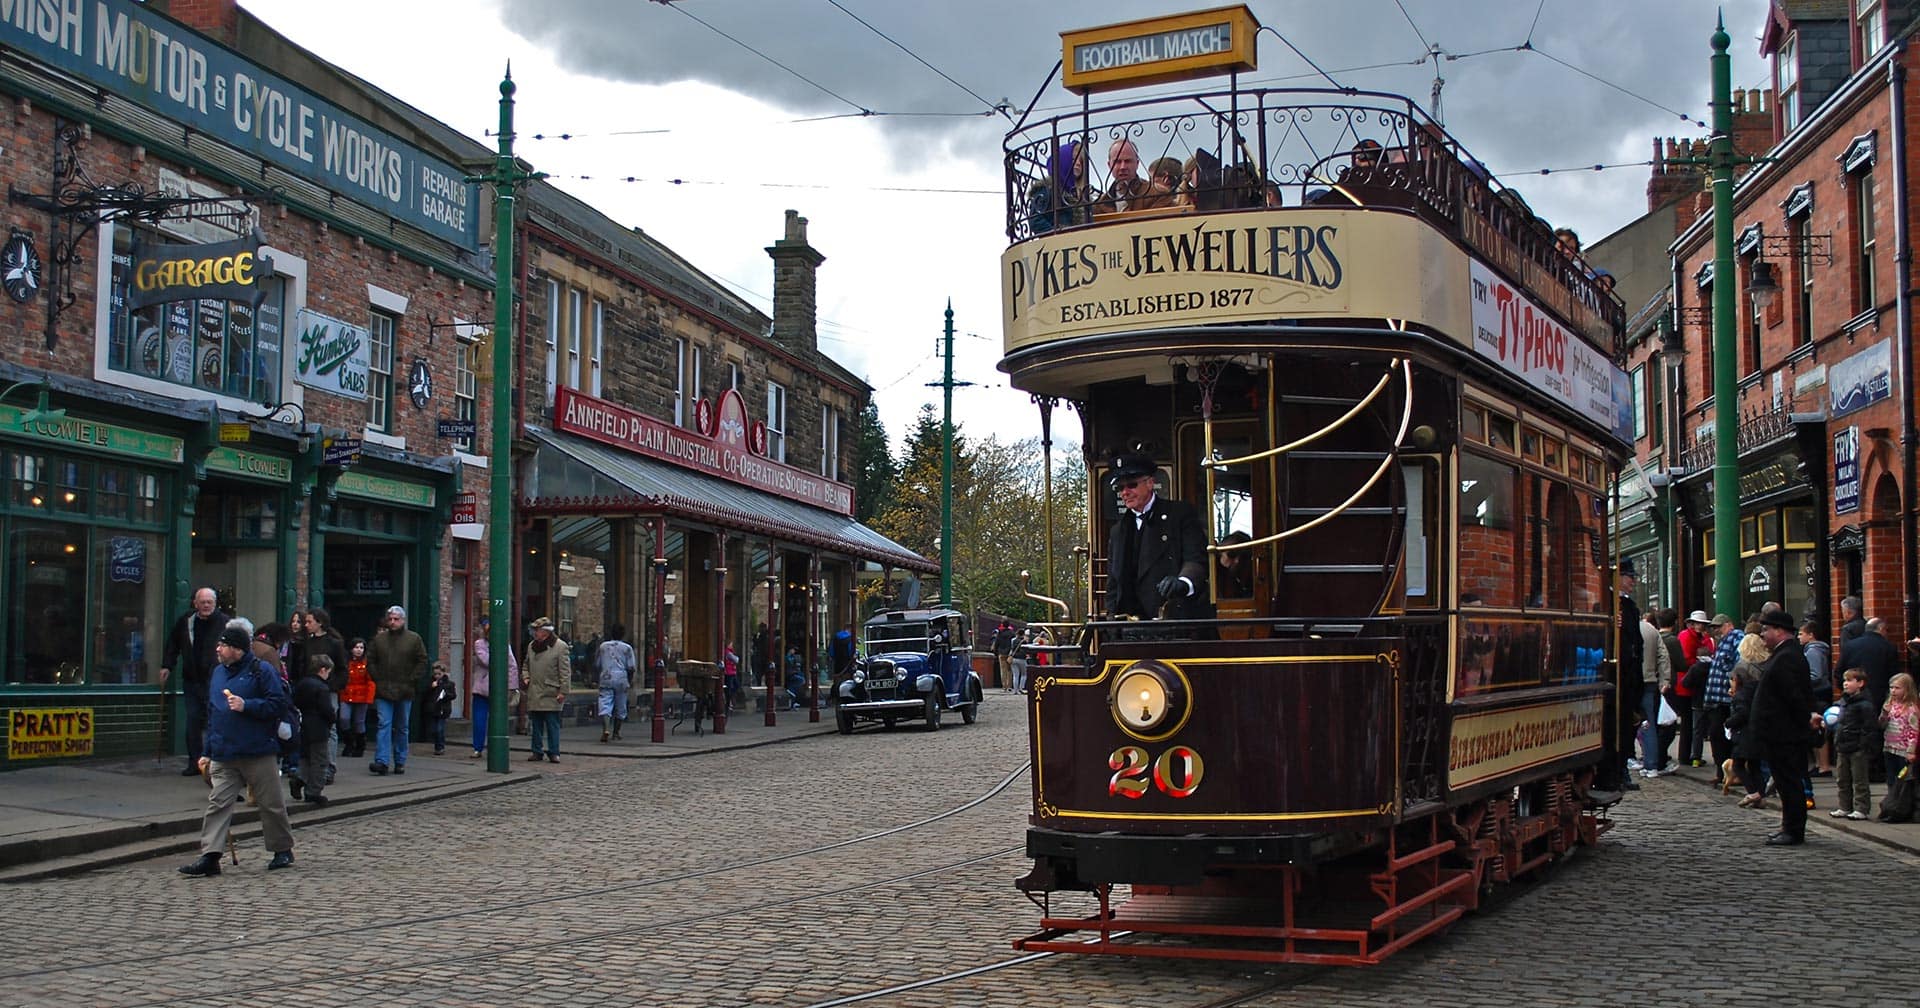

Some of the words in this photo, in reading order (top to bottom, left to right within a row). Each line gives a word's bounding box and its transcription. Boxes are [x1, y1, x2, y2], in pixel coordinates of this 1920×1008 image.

[1082, 39, 1159, 71] FOOTBALL
[1164, 28, 1222, 59] MATCH
[96, 2, 208, 115] MOTOR
[215, 75, 226, 110] &
[234, 73, 314, 163] CYCLE
[322, 115, 402, 203] WORKS
[423, 166, 466, 207] REPAIRS
[423, 193, 465, 232] GARAGE
[1464, 207, 1502, 265] OXTON
[137, 252, 254, 292] GARAGE
[1011, 244, 1099, 321] PYKES
[1101, 251, 1123, 269] THE
[1124, 221, 1342, 290] JEWELLERS
[1061, 292, 1204, 323] ESTABLISHED
[1210, 288, 1254, 308] 1877
[1473, 278, 1487, 304] TRY
[231, 321, 252, 335] CYCLES
[339, 362, 366, 394] CARS
[36, 416, 92, 443] COWIE
[440, 424, 475, 433] TELEPHONE
[565, 395, 628, 439] ANNFIELD
[630, 417, 663, 451] PLAIN
[666, 430, 720, 470] INDUSTRIAL
[786, 471, 817, 496] SOCIETY
[248, 457, 276, 477] COWIE
[1838, 464, 1853, 481] MILK
[455, 513, 474, 522] Oils
[13, 711, 91, 737] PRATT'S
[12, 740, 62, 755] PERFECTION
[65, 738, 91, 753] SPIRIT
[1450, 728, 1512, 771] BIRKENHEAD
[1513, 717, 1567, 752] CORPORATION
[1108, 745, 1204, 799] 20
